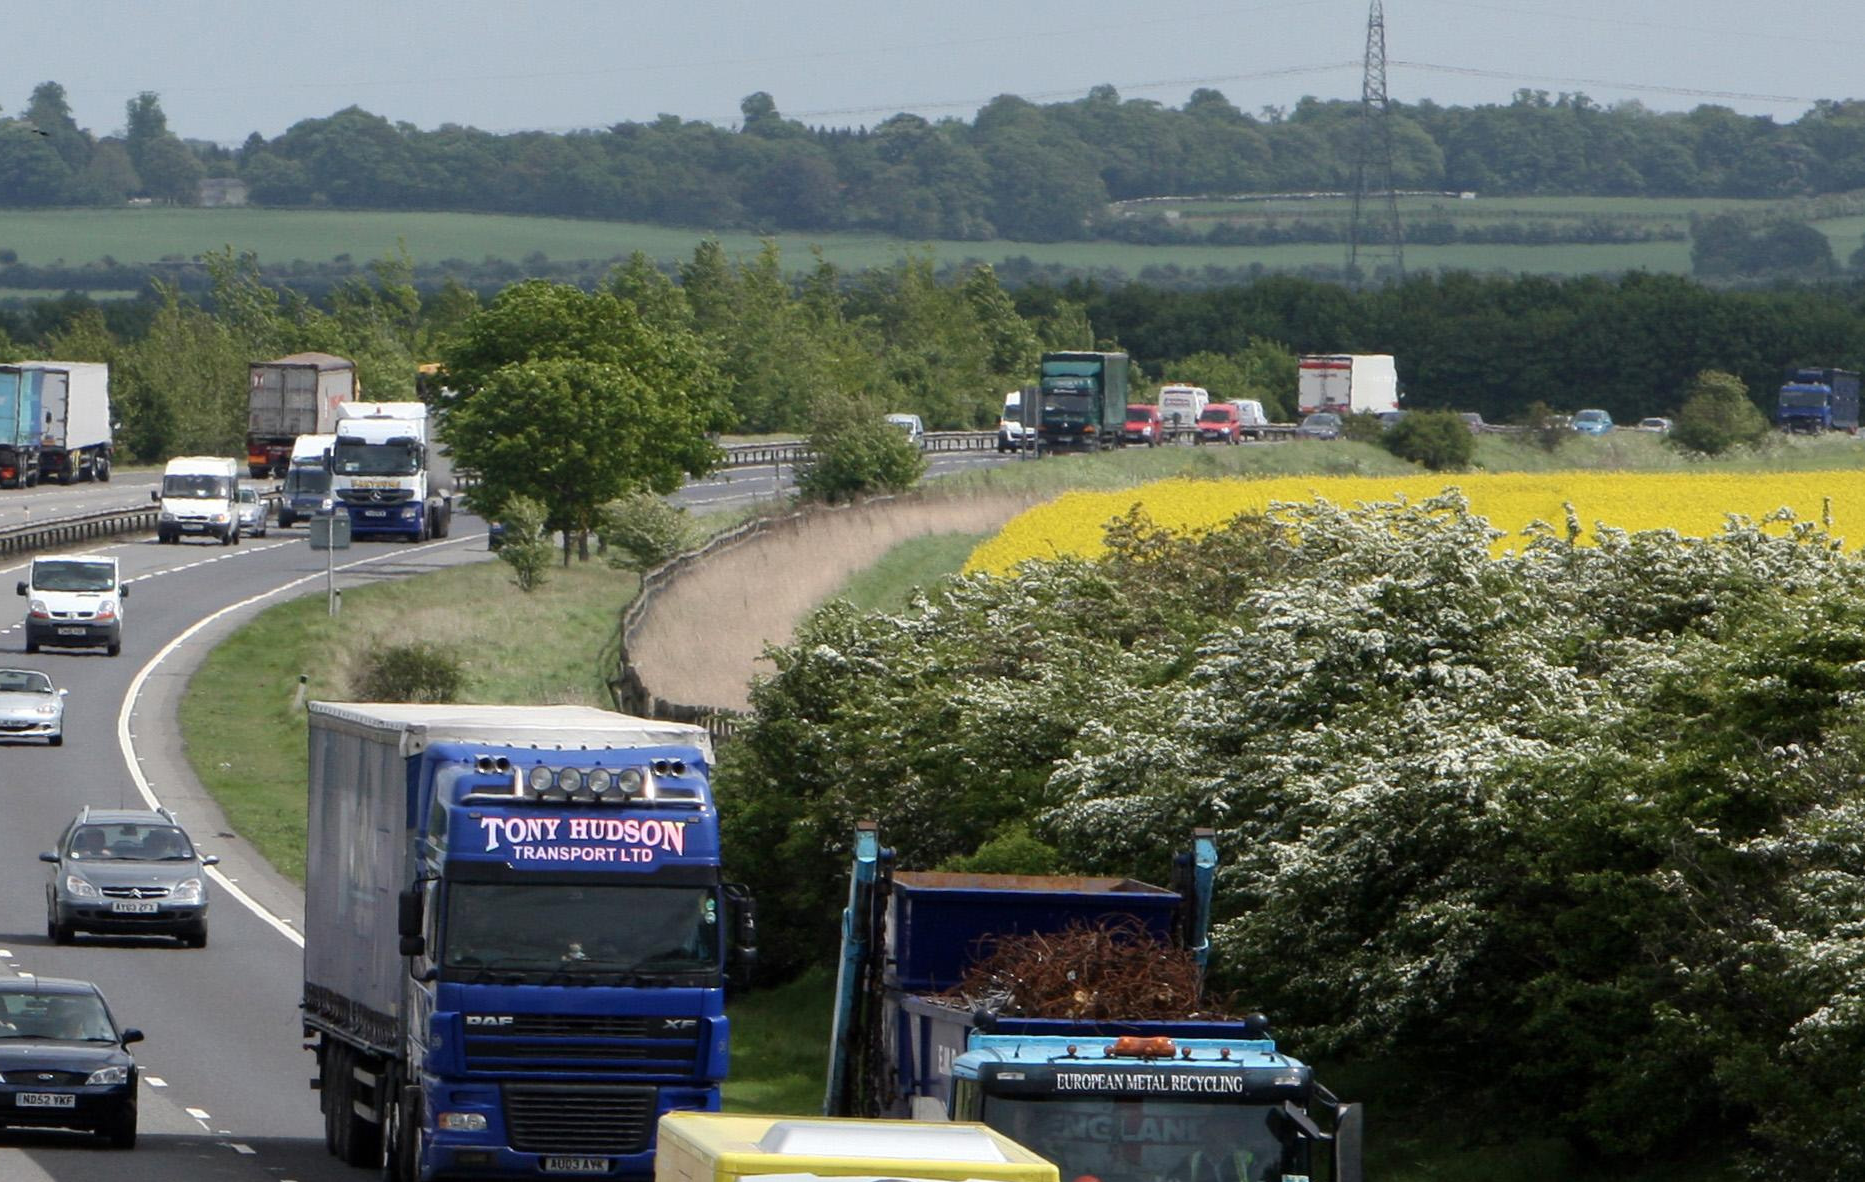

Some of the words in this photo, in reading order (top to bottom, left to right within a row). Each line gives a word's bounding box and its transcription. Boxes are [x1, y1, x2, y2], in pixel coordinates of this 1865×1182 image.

[481, 817, 561, 852] TONY
[569, 818, 686, 857] HUDSON
[513, 845, 617, 862] TRANSPORT
[621, 848, 653, 863] LTD
[466, 1015, 514, 1026] DAF
[662, 1018, 698, 1030] XF
[1056, 1073, 1124, 1090] EUROPEAN
[1126, 1074, 1169, 1091] METAL
[1171, 1074, 1243, 1093] RECYCLING
